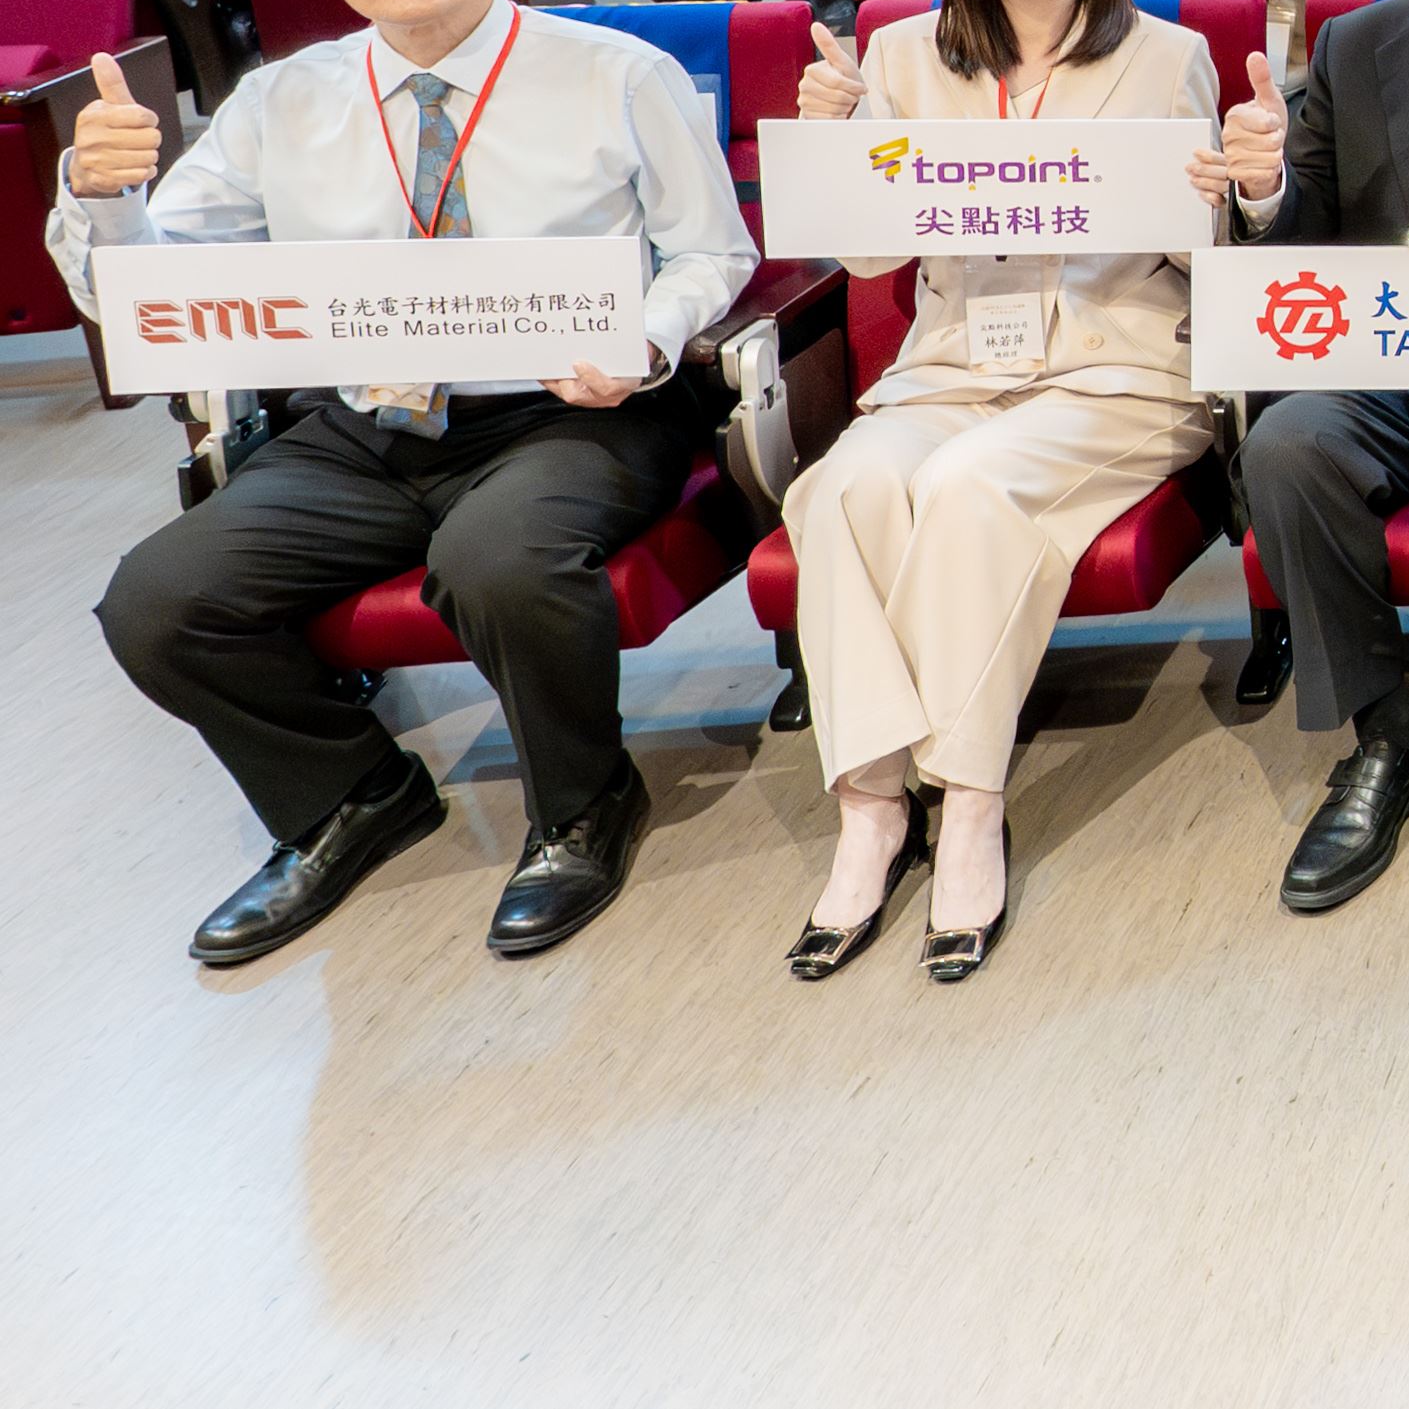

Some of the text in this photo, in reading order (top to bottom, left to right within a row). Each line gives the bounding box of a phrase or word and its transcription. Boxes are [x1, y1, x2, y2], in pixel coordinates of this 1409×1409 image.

[911, 147, 1090, 191] topoint
[915, 205, 1091, 236] 尖點科技
[134, 296, 314, 344] EMC
[327, 292, 617, 318] 台光電子材料股份有限公司
[331, 314, 619, 339] Elite Material Co., Ltd.
